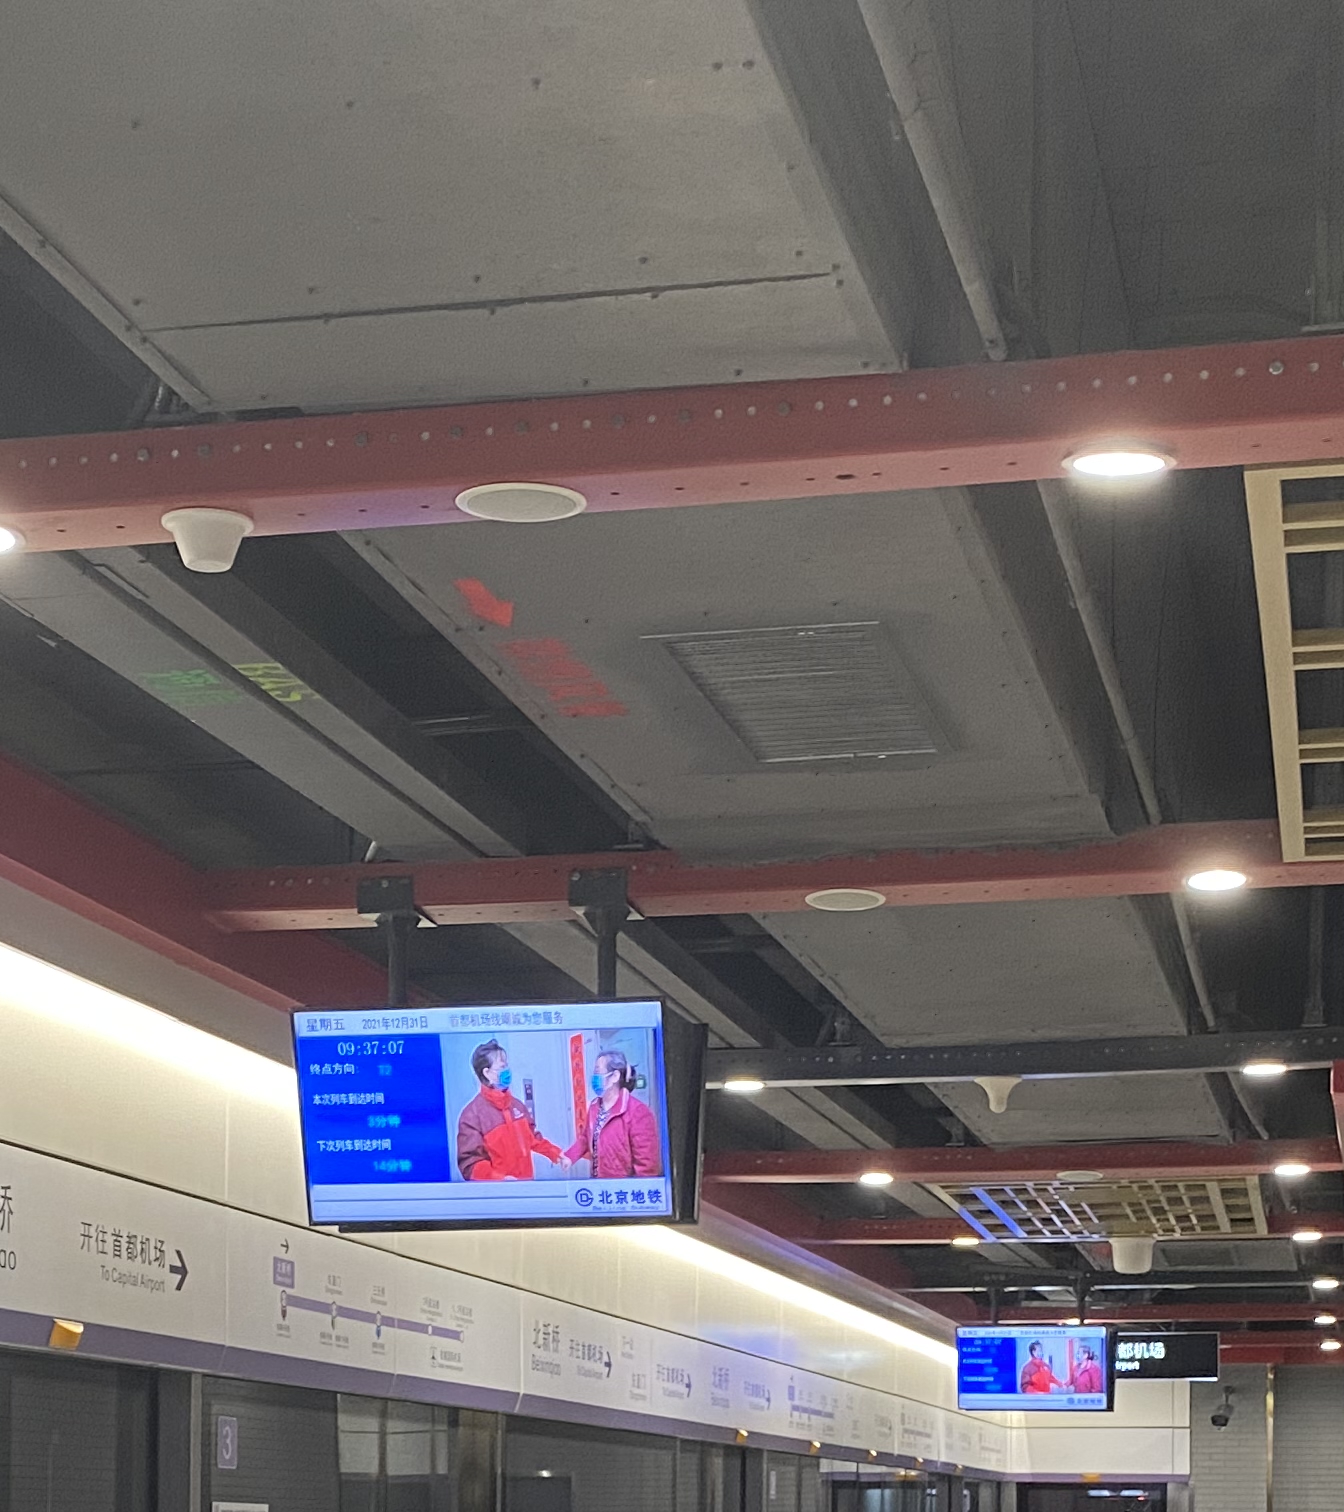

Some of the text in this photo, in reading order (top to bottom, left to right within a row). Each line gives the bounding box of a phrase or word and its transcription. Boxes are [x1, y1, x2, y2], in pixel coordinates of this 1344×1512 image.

[306, 1018, 345, 1032] 星期五
[362, 1016, 428, 1030] 2021年12月31日
[337, 1041, 405, 1055] 09:37:07
[312, 1092, 385, 1105] 本次列车到达时间
[317, 1139, 392, 1152] 下次列车到达时间
[598, 1189, 662, 1204] 北京地铁
[80, 1221, 167, 1269] 开往首都机场
[100, 1264, 166, 1293] To Capital Airport
[1118, 1341, 1165, 1359] 都机场
[222, 1426, 232, 1459] 3
